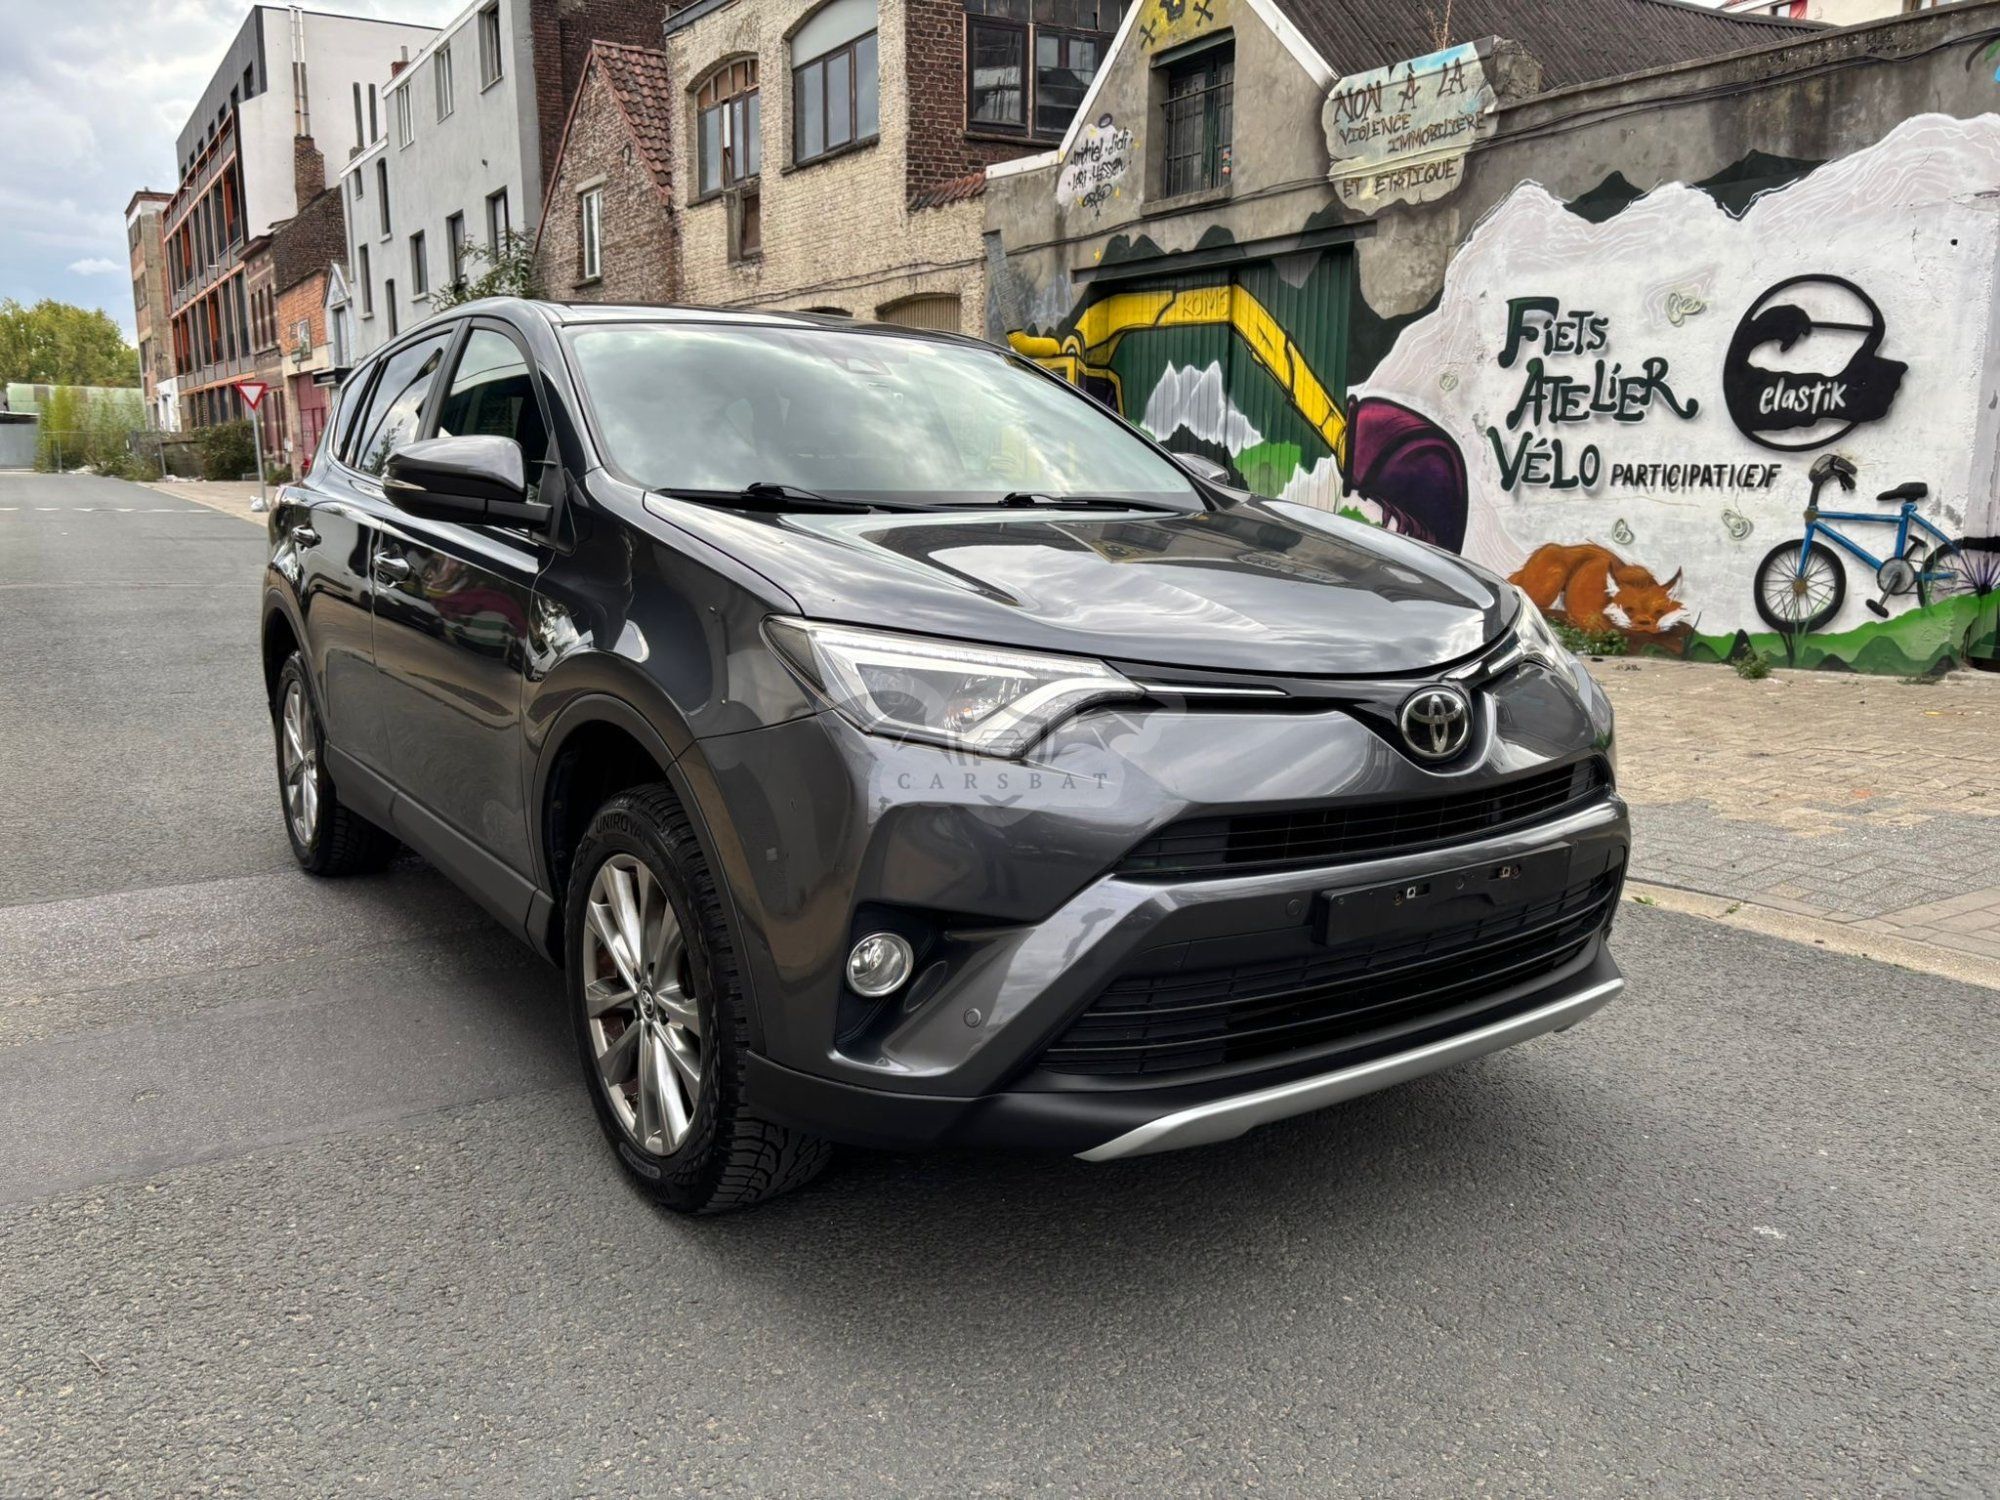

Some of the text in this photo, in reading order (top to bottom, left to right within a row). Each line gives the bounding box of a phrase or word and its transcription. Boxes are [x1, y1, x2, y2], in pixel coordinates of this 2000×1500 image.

[1333, 80, 1382, 125] NON
[1437, 57, 1467, 97] LA
[1339, 113, 1412, 146] VIOLENCE
[1343, 176, 1361, 198] ET
[1759, 377, 1847, 414] elastik
[1486, 426, 1782, 491] VÉLO PARTICIPATI(E)F
